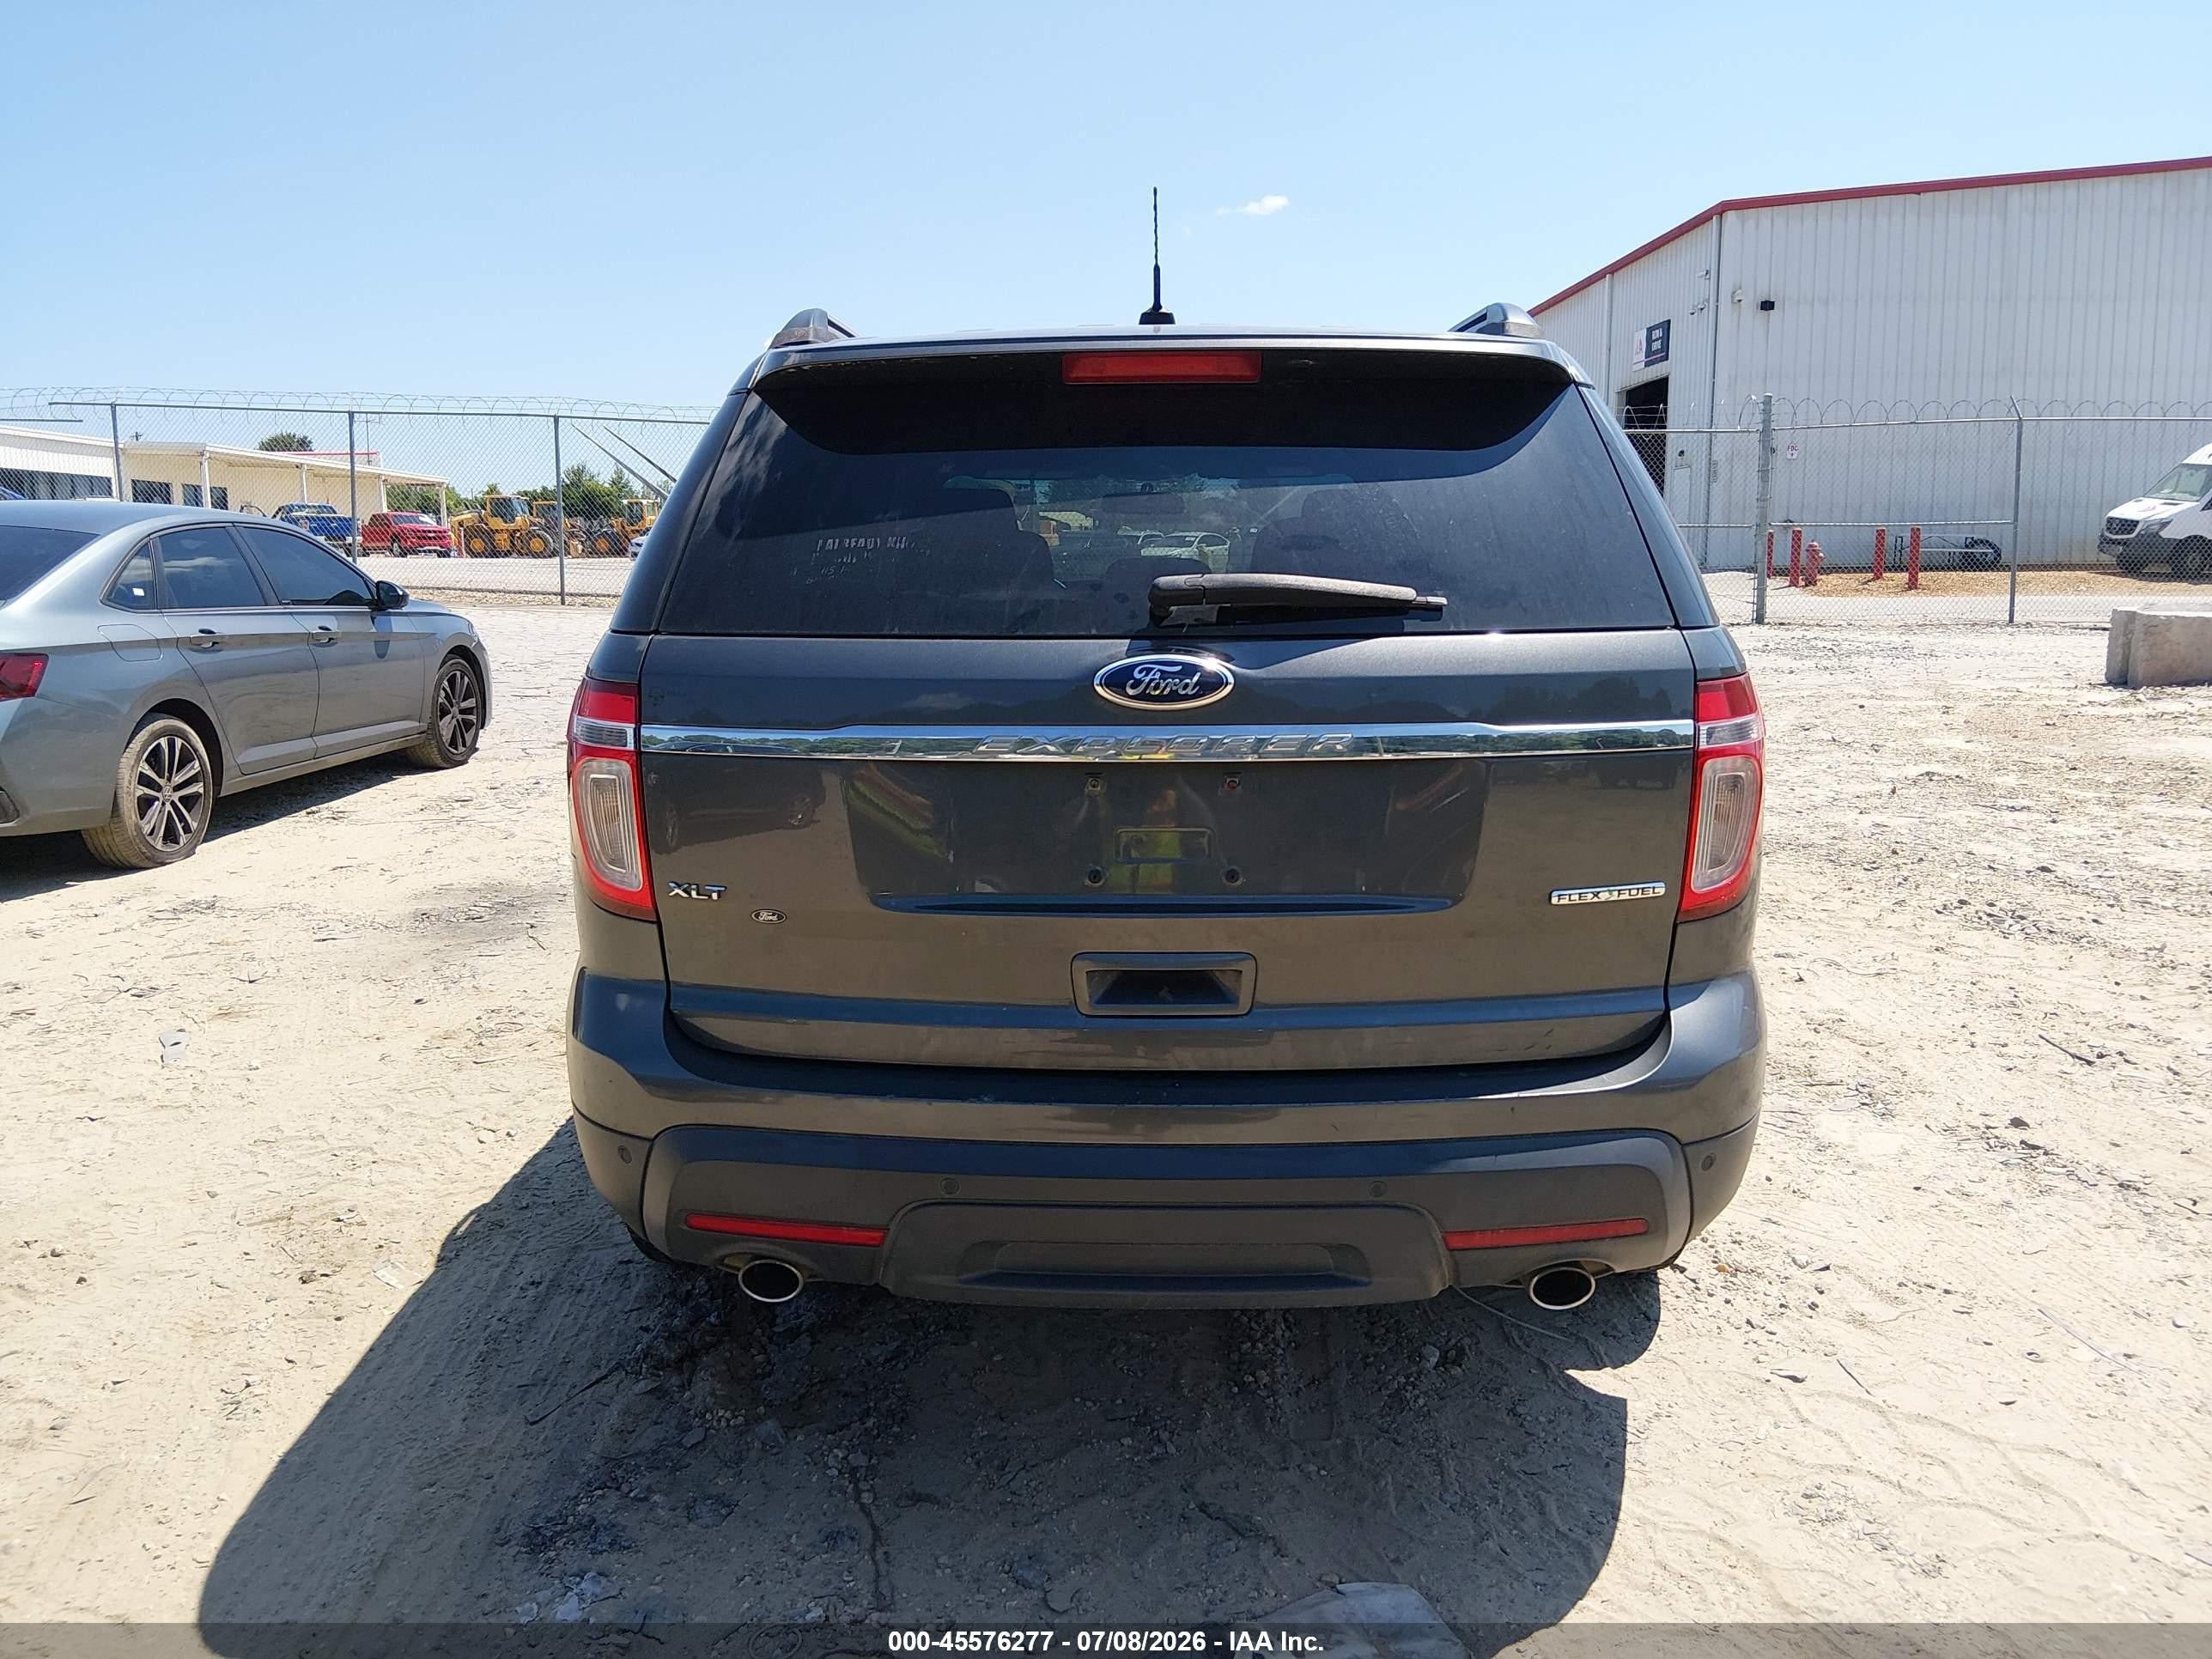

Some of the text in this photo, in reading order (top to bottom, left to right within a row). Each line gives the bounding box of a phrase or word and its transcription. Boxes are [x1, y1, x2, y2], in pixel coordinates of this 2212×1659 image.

[1126, 664, 1201, 696] Ford
[974, 732, 1355, 753] EXPLORER
[667, 881, 727, 901] XLT
[1557, 886, 1662, 903] FLEX FUEL
[758, 911, 779, 921] Ford
